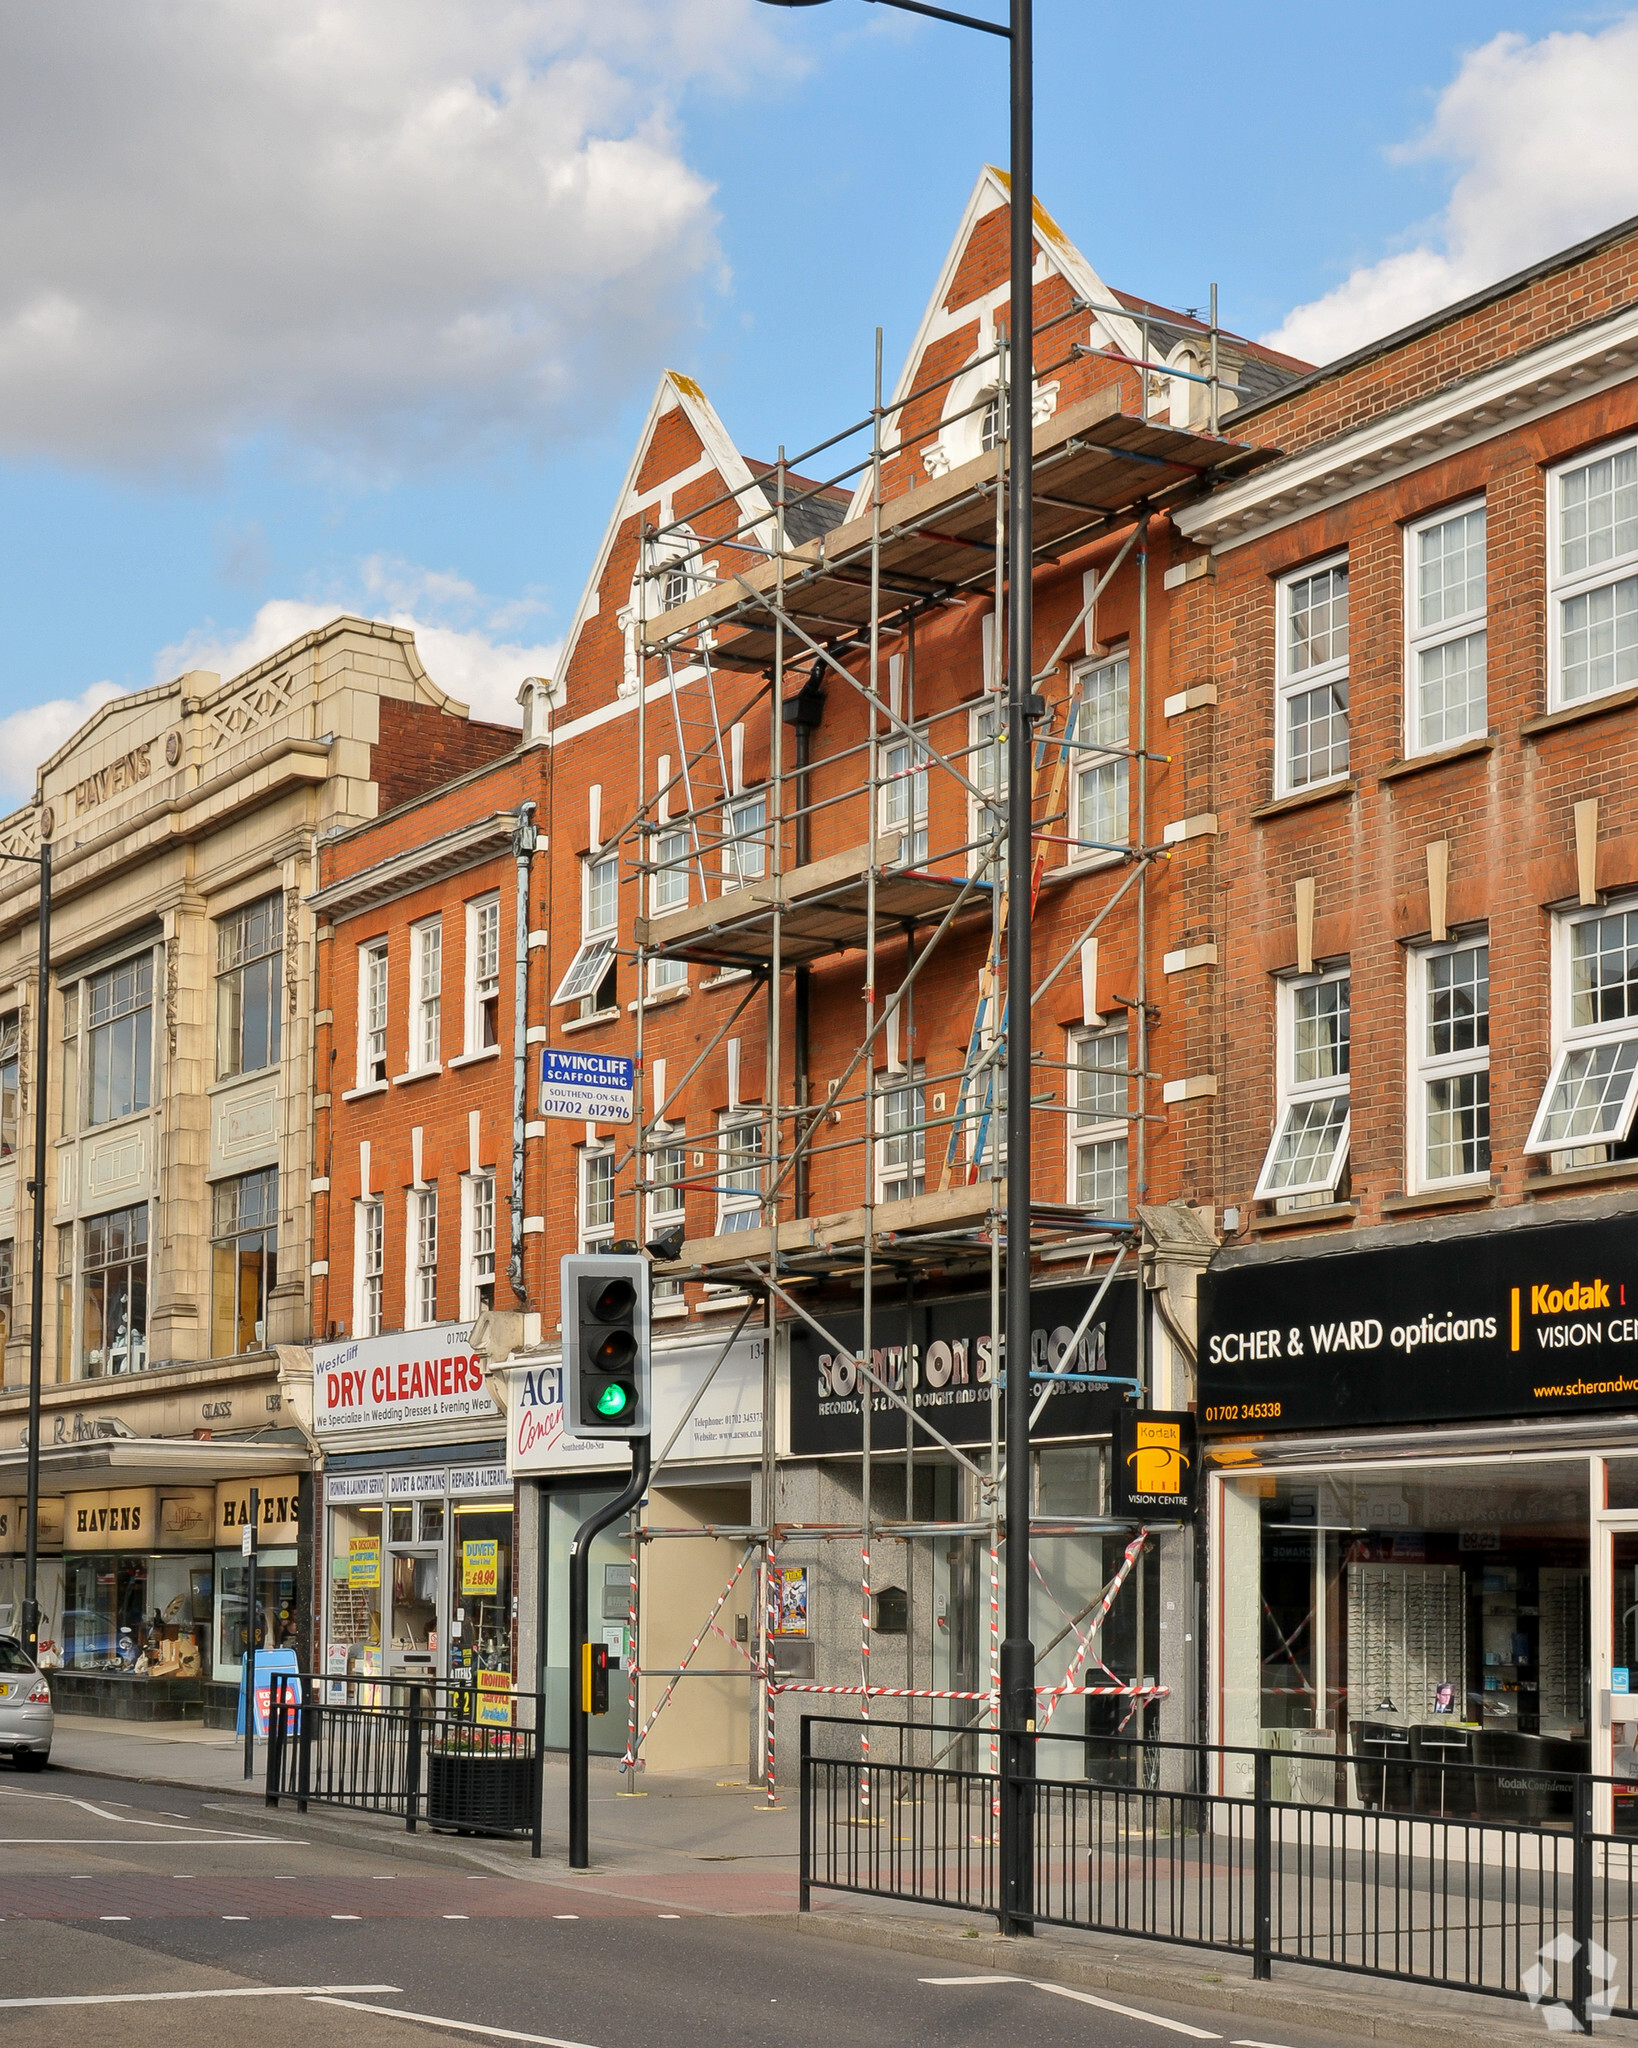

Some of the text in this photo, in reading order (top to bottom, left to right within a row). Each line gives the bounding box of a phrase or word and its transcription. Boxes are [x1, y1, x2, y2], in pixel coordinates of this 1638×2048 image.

[75, 743, 151, 818] HAVENS
[547, 1053, 628, 1075] TWINCLIFF
[547, 1069, 628, 1087] SCAFFOLDING
[544, 1099, 630, 1119] 01702 612996
[1531, 1279, 1610, 1315] Kodak
[446, 1331, 468, 1346] 01702
[1209, 1311, 1497, 1364] SCHER & WARD opticians
[1536, 1321, 1602, 1349] VISION
[315, 1344, 359, 1375] Westcliff
[925, 1337, 970, 1388] ON
[327, 1353, 483, 1409] DRY CLEANERS
[202, 1400, 233, 1419] GLASS
[818, 1399, 860, 1416] RECORDS,
[915, 1390, 955, 1408] BOUGHT
[956, 1388, 976, 1404] AND
[316, 1398, 492, 1428] We Specialize In Wedding Dresses & Evening Wear
[1205, 1402, 1282, 1422] 01702 345338
[694, 1417, 724, 1429] Telephone:
[724, 1415, 742, 1425] 01702
[693, 1431, 718, 1442] Website:
[1139, 1426, 1178, 1440] Kodak
[391, 1474, 445, 1493] DUVET & CURTAINS
[451, 1471, 474, 1489] REPAIRS
[475, 1471, 480, 1487] &
[1128, 1494, 1188, 1506] VISION CENTRE
[76, 1506, 142, 1533] HAVENS
[223, 1495, 300, 1527] HAENS
[465, 1543, 495, 1557] DUVETS
[471, 1569, 495, 1586] £9.99
[480, 1672, 510, 1689] IRONING
[480, 1705, 508, 1723] Available
[1235, 1762, 1255, 1775] SCH
[1498, 1776, 1528, 1790] Kodak
[1527, 1779, 1574, 1794] Confidence
